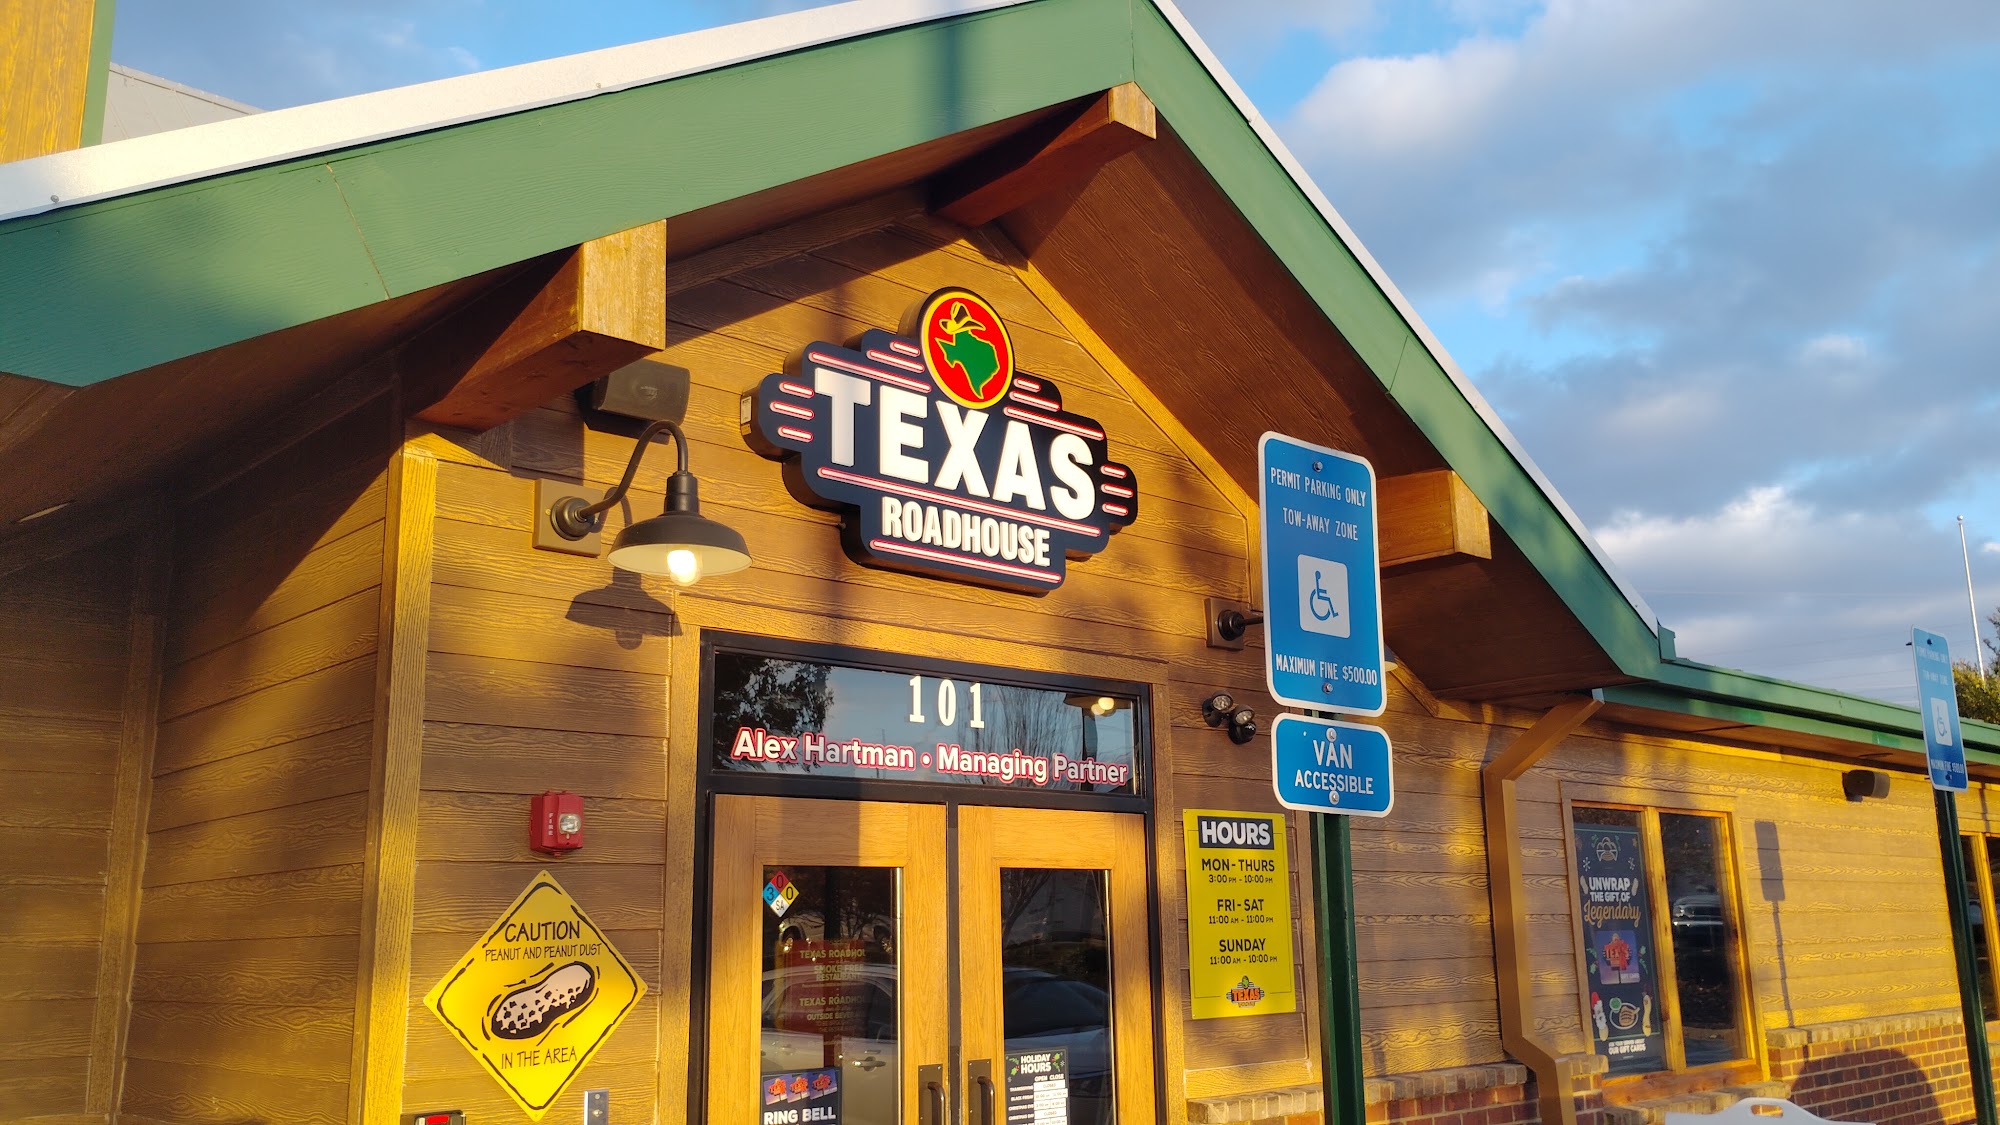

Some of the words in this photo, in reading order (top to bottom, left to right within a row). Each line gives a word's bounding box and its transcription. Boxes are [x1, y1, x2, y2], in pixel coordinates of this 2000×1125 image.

[815, 368, 1096, 520] TEXAS
[1271, 467, 1300, 490] PERMIT
[1305, 477, 1341, 500] PARKING
[1345, 487, 1366, 507] ONLY
[882, 496, 1050, 567] ROADHOUSE
[1283, 508, 1330, 534] TOW-AWAY
[1336, 521, 1358, 541] ZONE
[1276, 654, 1315, 676] MAXIMUM
[1320, 661, 1338, 680] FINE
[1342, 666, 1378, 686] $500.00
[908, 675, 985, 729] 101
[732, 728, 798, 762] Alex
[804, 733, 914, 769] Hartman
[938, 744, 1048, 784] Managing
[1053, 753, 1128, 785] Partner
[1313, 740, 1352, 769] VAN
[1295, 769, 1374, 794] ACCESSIBLE
[1201, 821, 1270, 846] HOURS
[776, 875, 783, 888] 0
[1209, 875, 1227, 883] 3:00
[1244, 875, 1264, 883] 10:00
[1589, 877, 1630, 891] UNWRAP
[766, 887, 774, 901] 3
[786, 887, 793, 900] 0
[1590, 892, 1604, 902] THE
[1605, 892, 1619, 902] GIFT
[1620, 892, 1630, 902] OF
[1209, 916, 1229, 924] 11:00
[1246, 915, 1264, 924] 11:00
[1584, 900, 1641, 928] Legendary
[504, 920, 580, 942] CAUTION
[1219, 938, 1266, 952] SUNDAY
[485, 947, 521, 962] PEANUT
[522, 946, 541, 960] AND
[544, 944, 577, 959] PEANUT
[579, 943, 602, 956] DUST
[800, 950, 826, 959] TEXAS
[1210, 956, 1231, 965] 11:00
[1248, 954, 1268, 963] 10:00
[814, 965, 841, 973] SMOKE
[800, 998, 826, 1006] TEXAS
[1232, 989, 1260, 1001] TEXAS
[1630, 1043, 1646, 1052] CARDS
[501, 1054, 513, 1069] IN
[517, 1050, 540, 1067] THE
[544, 1046, 577, 1065] AREA
[1021, 1054, 1050, 1063] HOLIDAY
[1021, 1062, 1051, 1074] HOURS
[764, 1110, 798, 1124] RING
[802, 1107, 836, 1122] BELL
